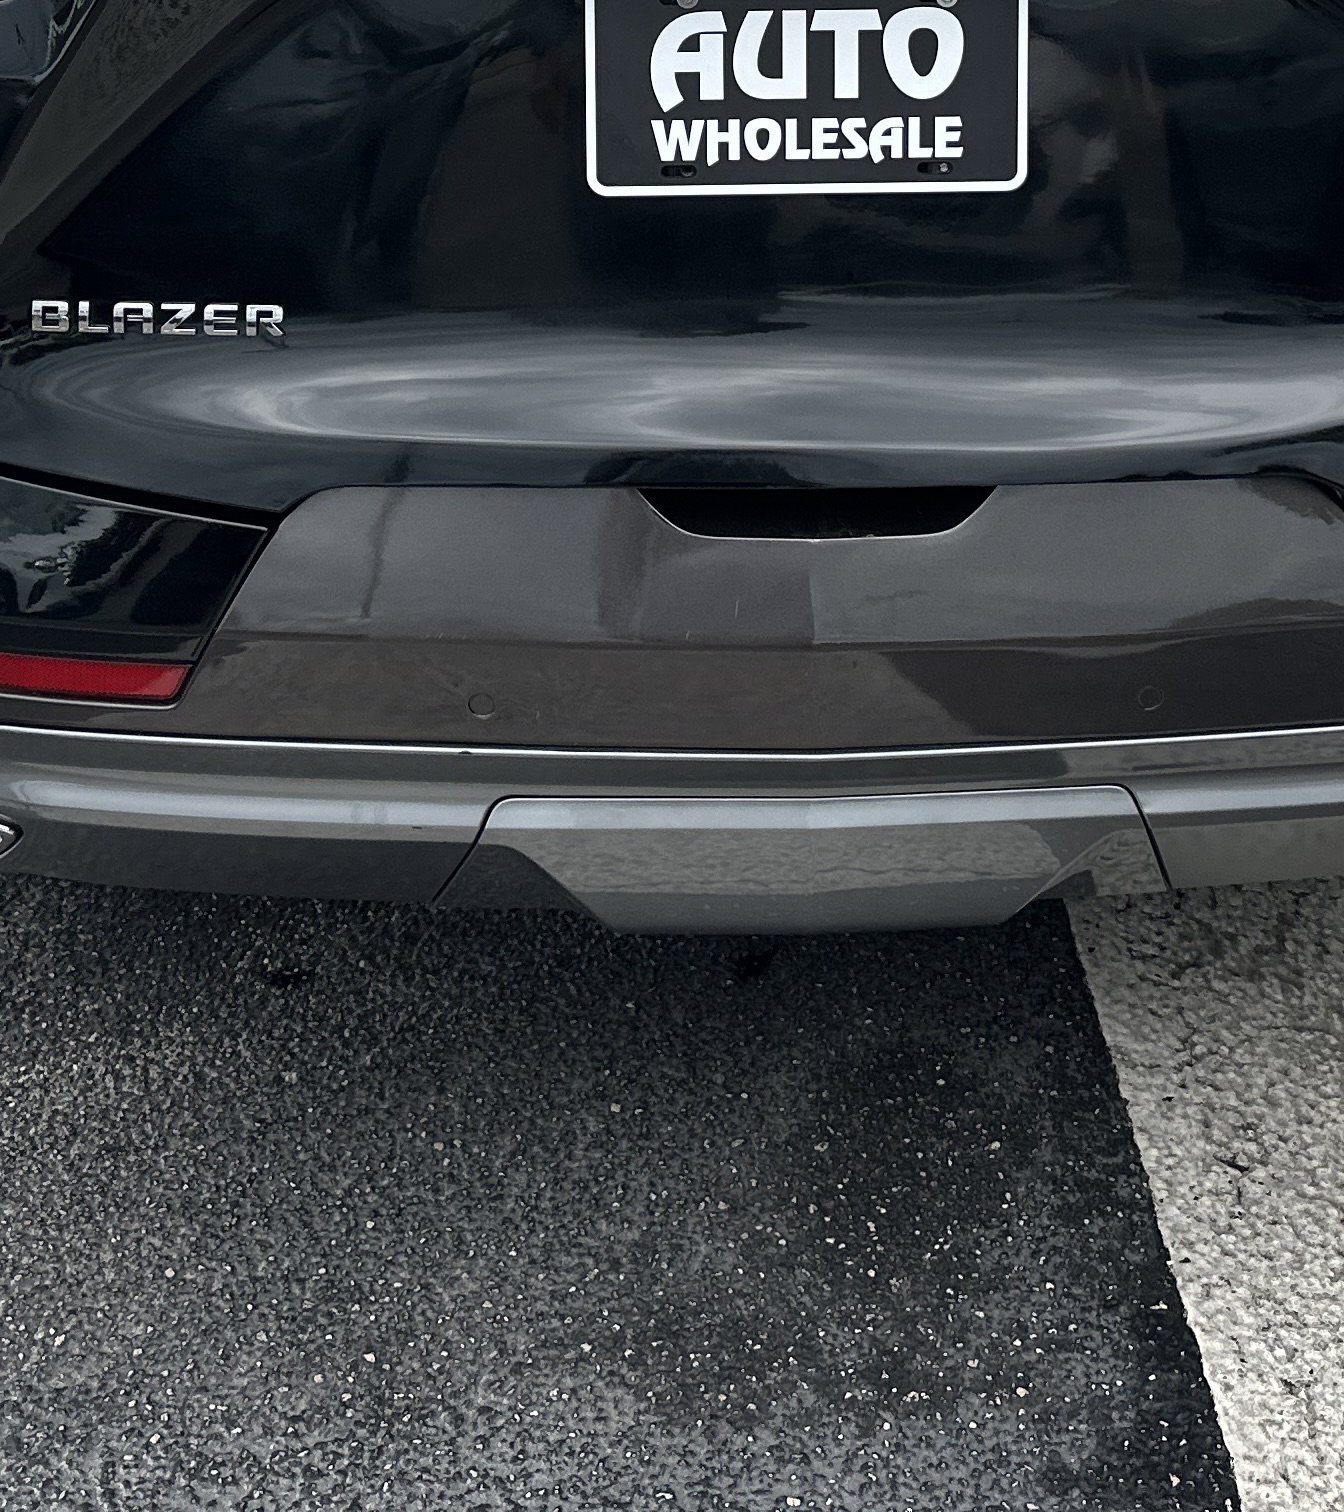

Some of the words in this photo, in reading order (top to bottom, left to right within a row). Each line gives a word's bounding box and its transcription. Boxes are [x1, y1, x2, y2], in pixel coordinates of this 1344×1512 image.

[649, 6, 964, 113] AUTO
[650, 115, 964, 166] WHOLESALE
[31, 299, 285, 337] BLAZER
